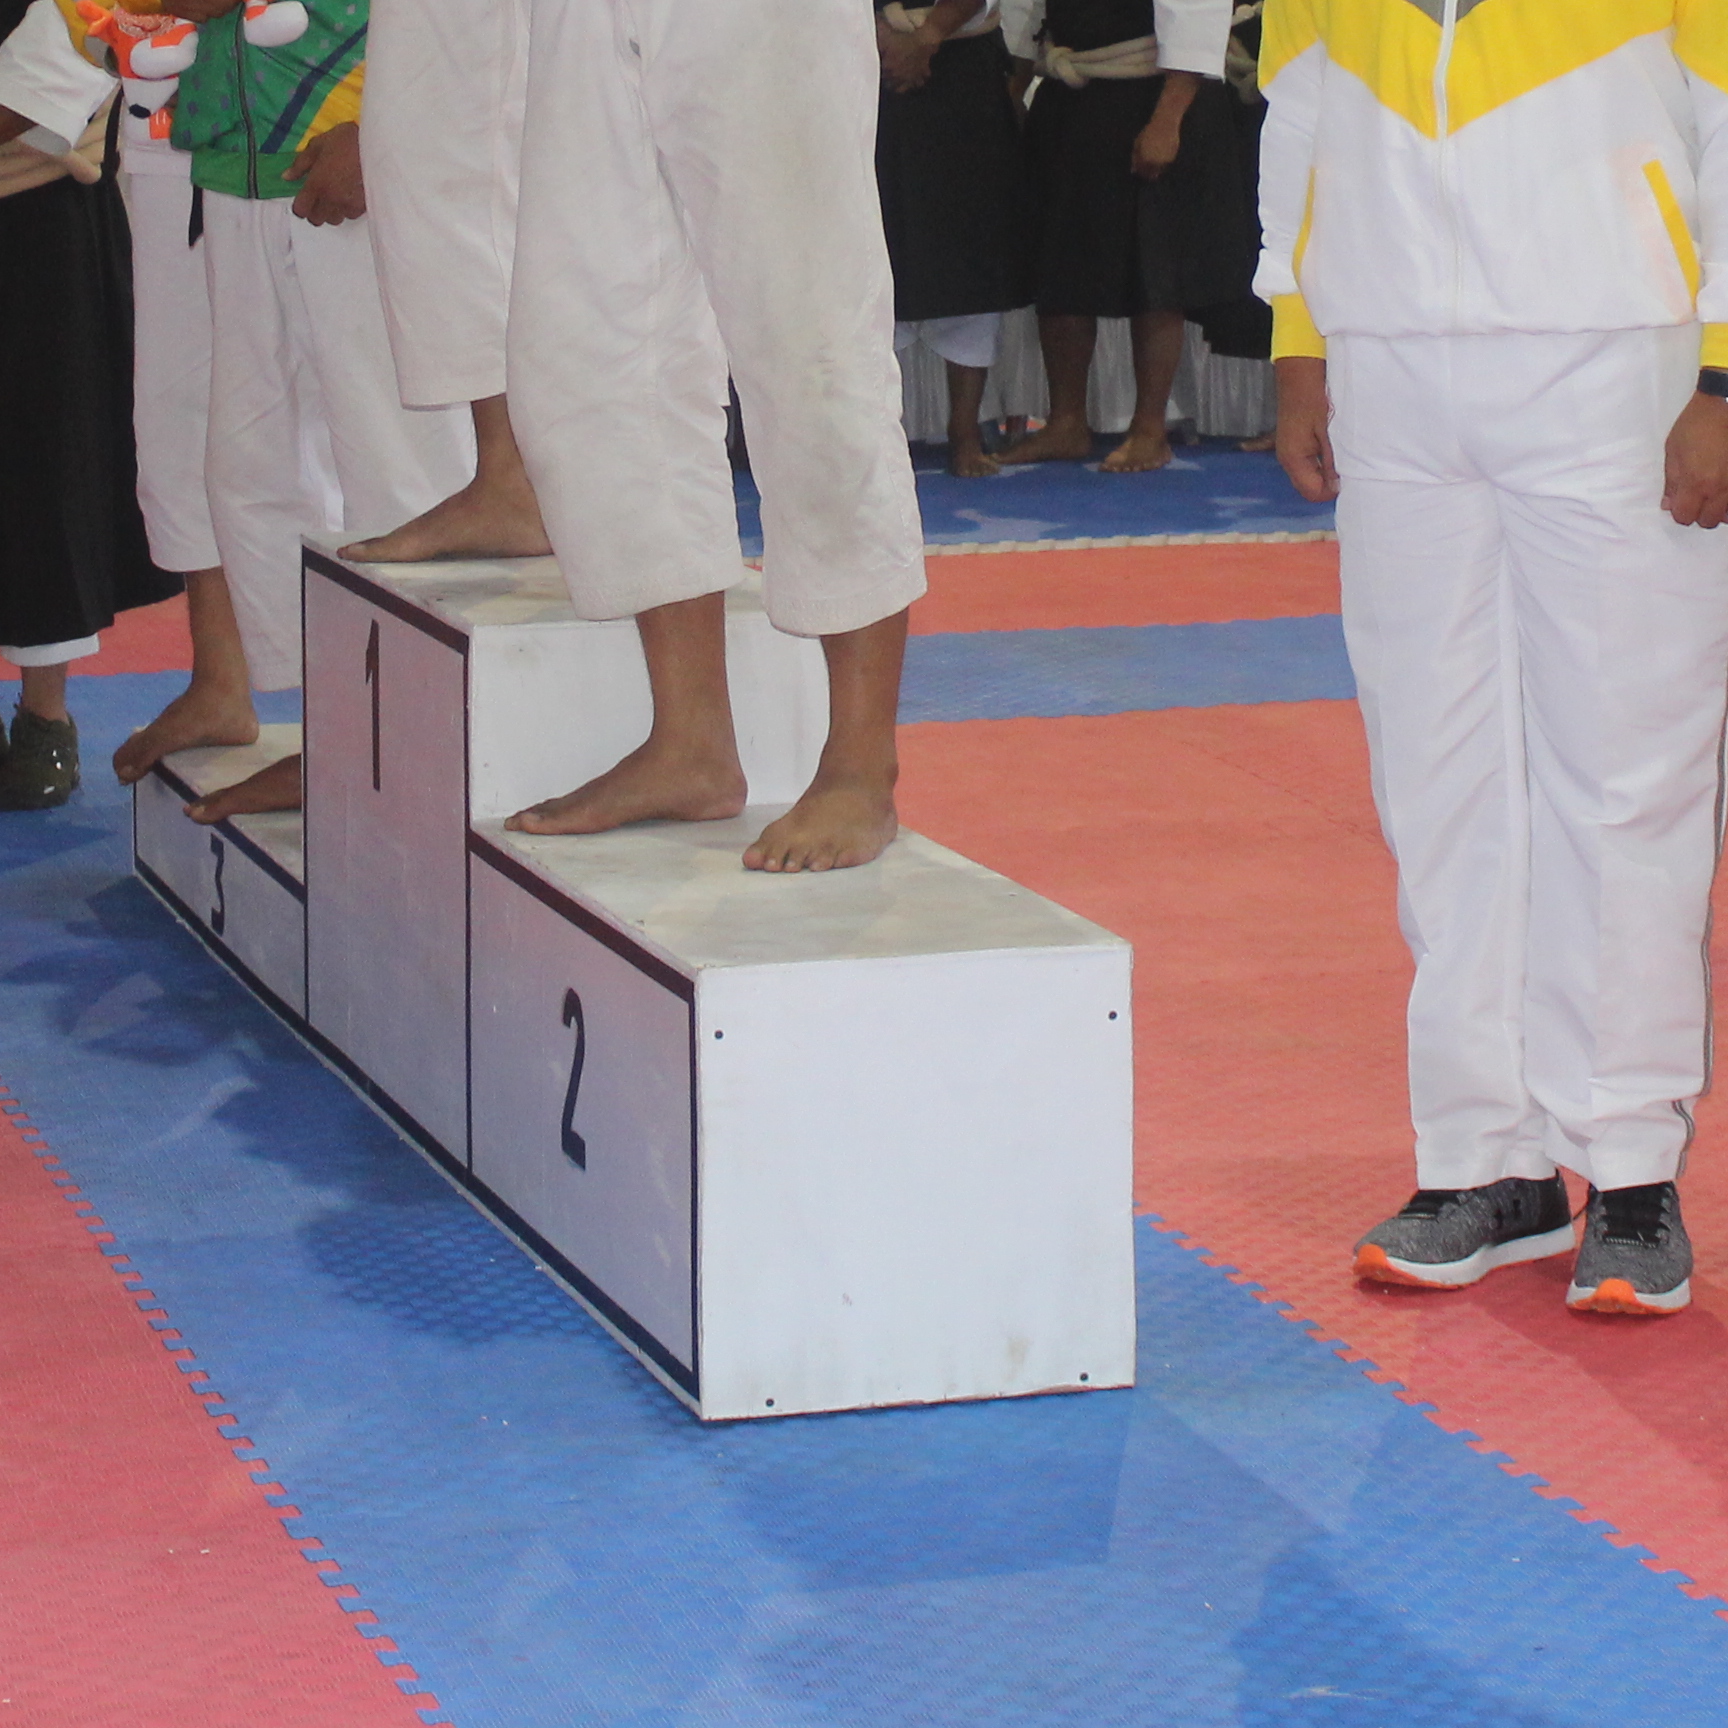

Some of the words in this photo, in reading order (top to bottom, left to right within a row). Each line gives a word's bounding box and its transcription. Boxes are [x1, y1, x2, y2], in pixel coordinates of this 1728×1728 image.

[365, 618, 380, 792] 1
[209, 833, 225, 936] 3
[561, 986, 587, 1172] 2
